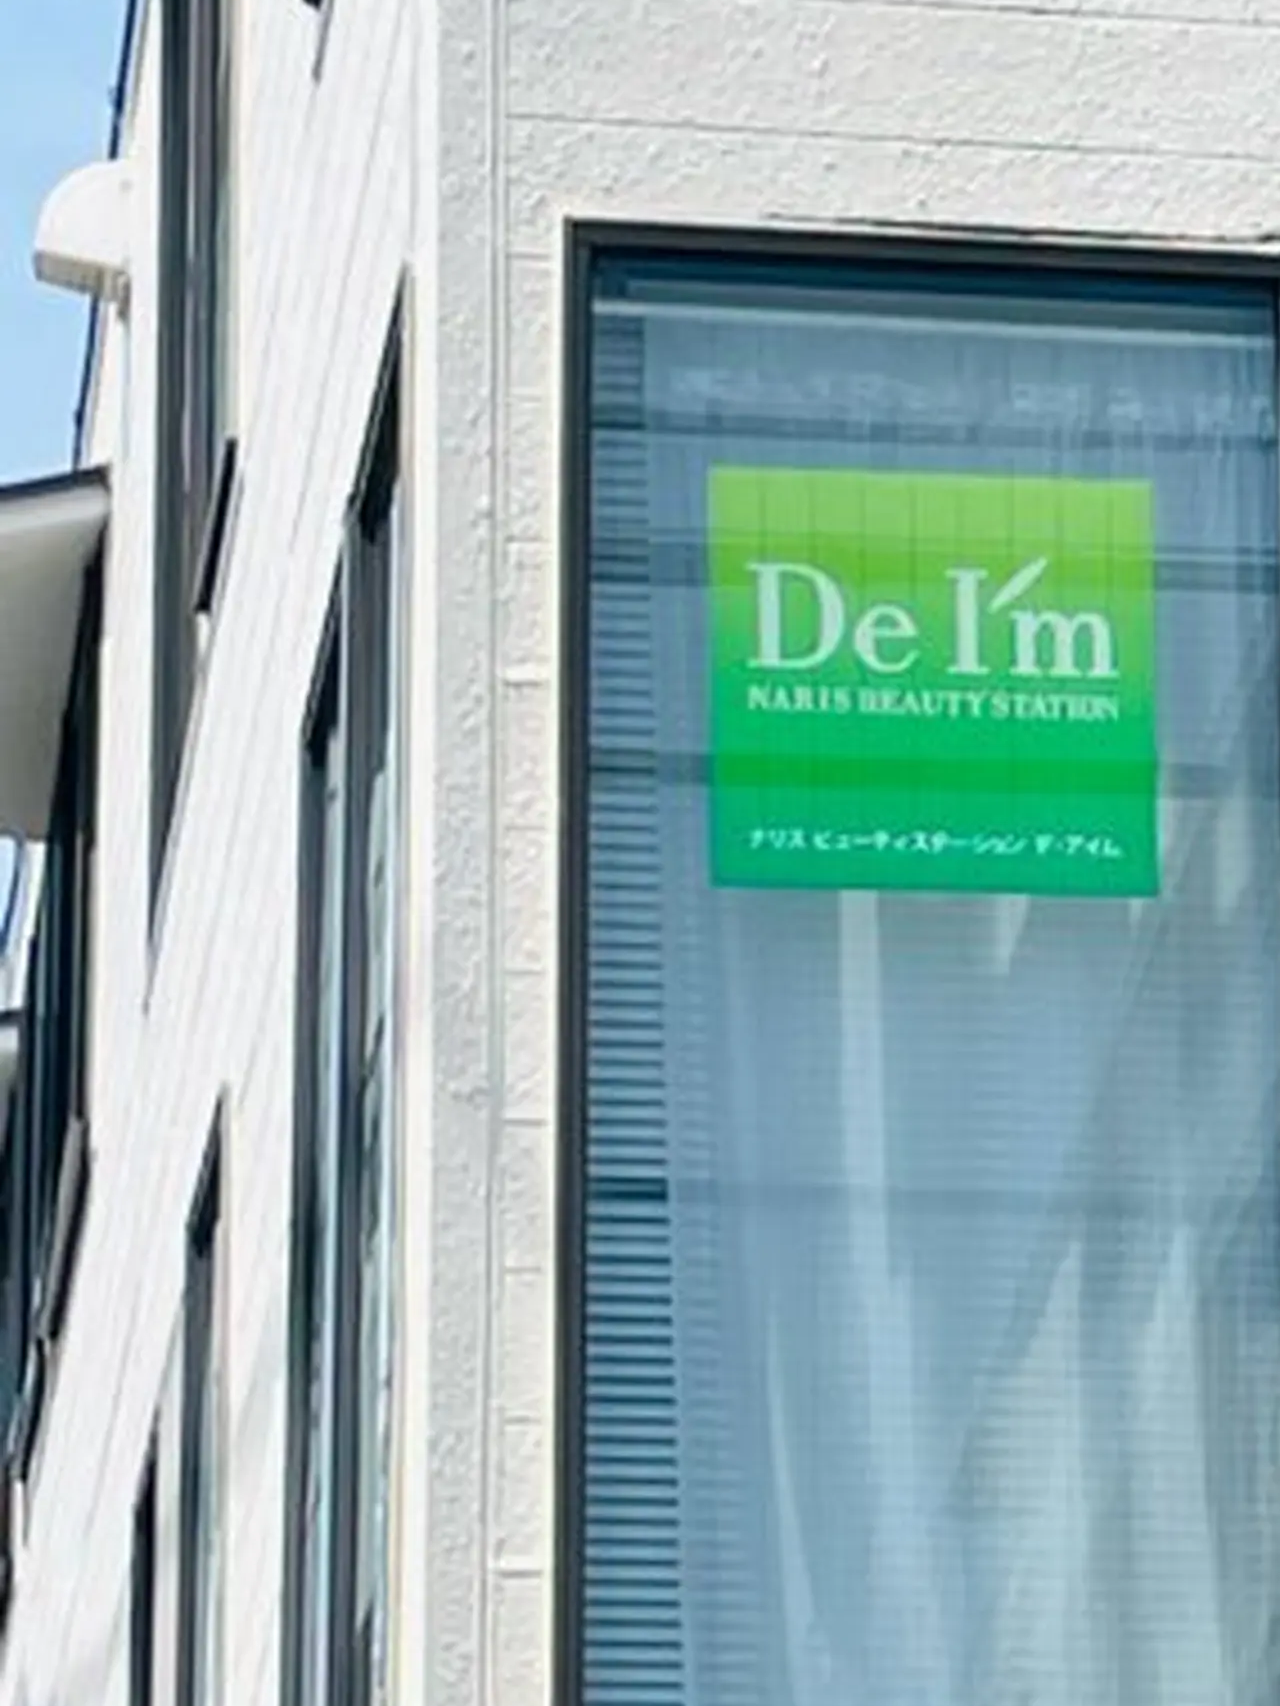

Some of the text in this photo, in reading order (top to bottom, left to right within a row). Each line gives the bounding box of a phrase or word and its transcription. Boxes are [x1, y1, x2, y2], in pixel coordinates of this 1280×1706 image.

[745, 561, 920, 674] De
[747, 684, 1121, 723] NARIS BEAUTY STATION
[749, 829, 806, 852] ナリス
